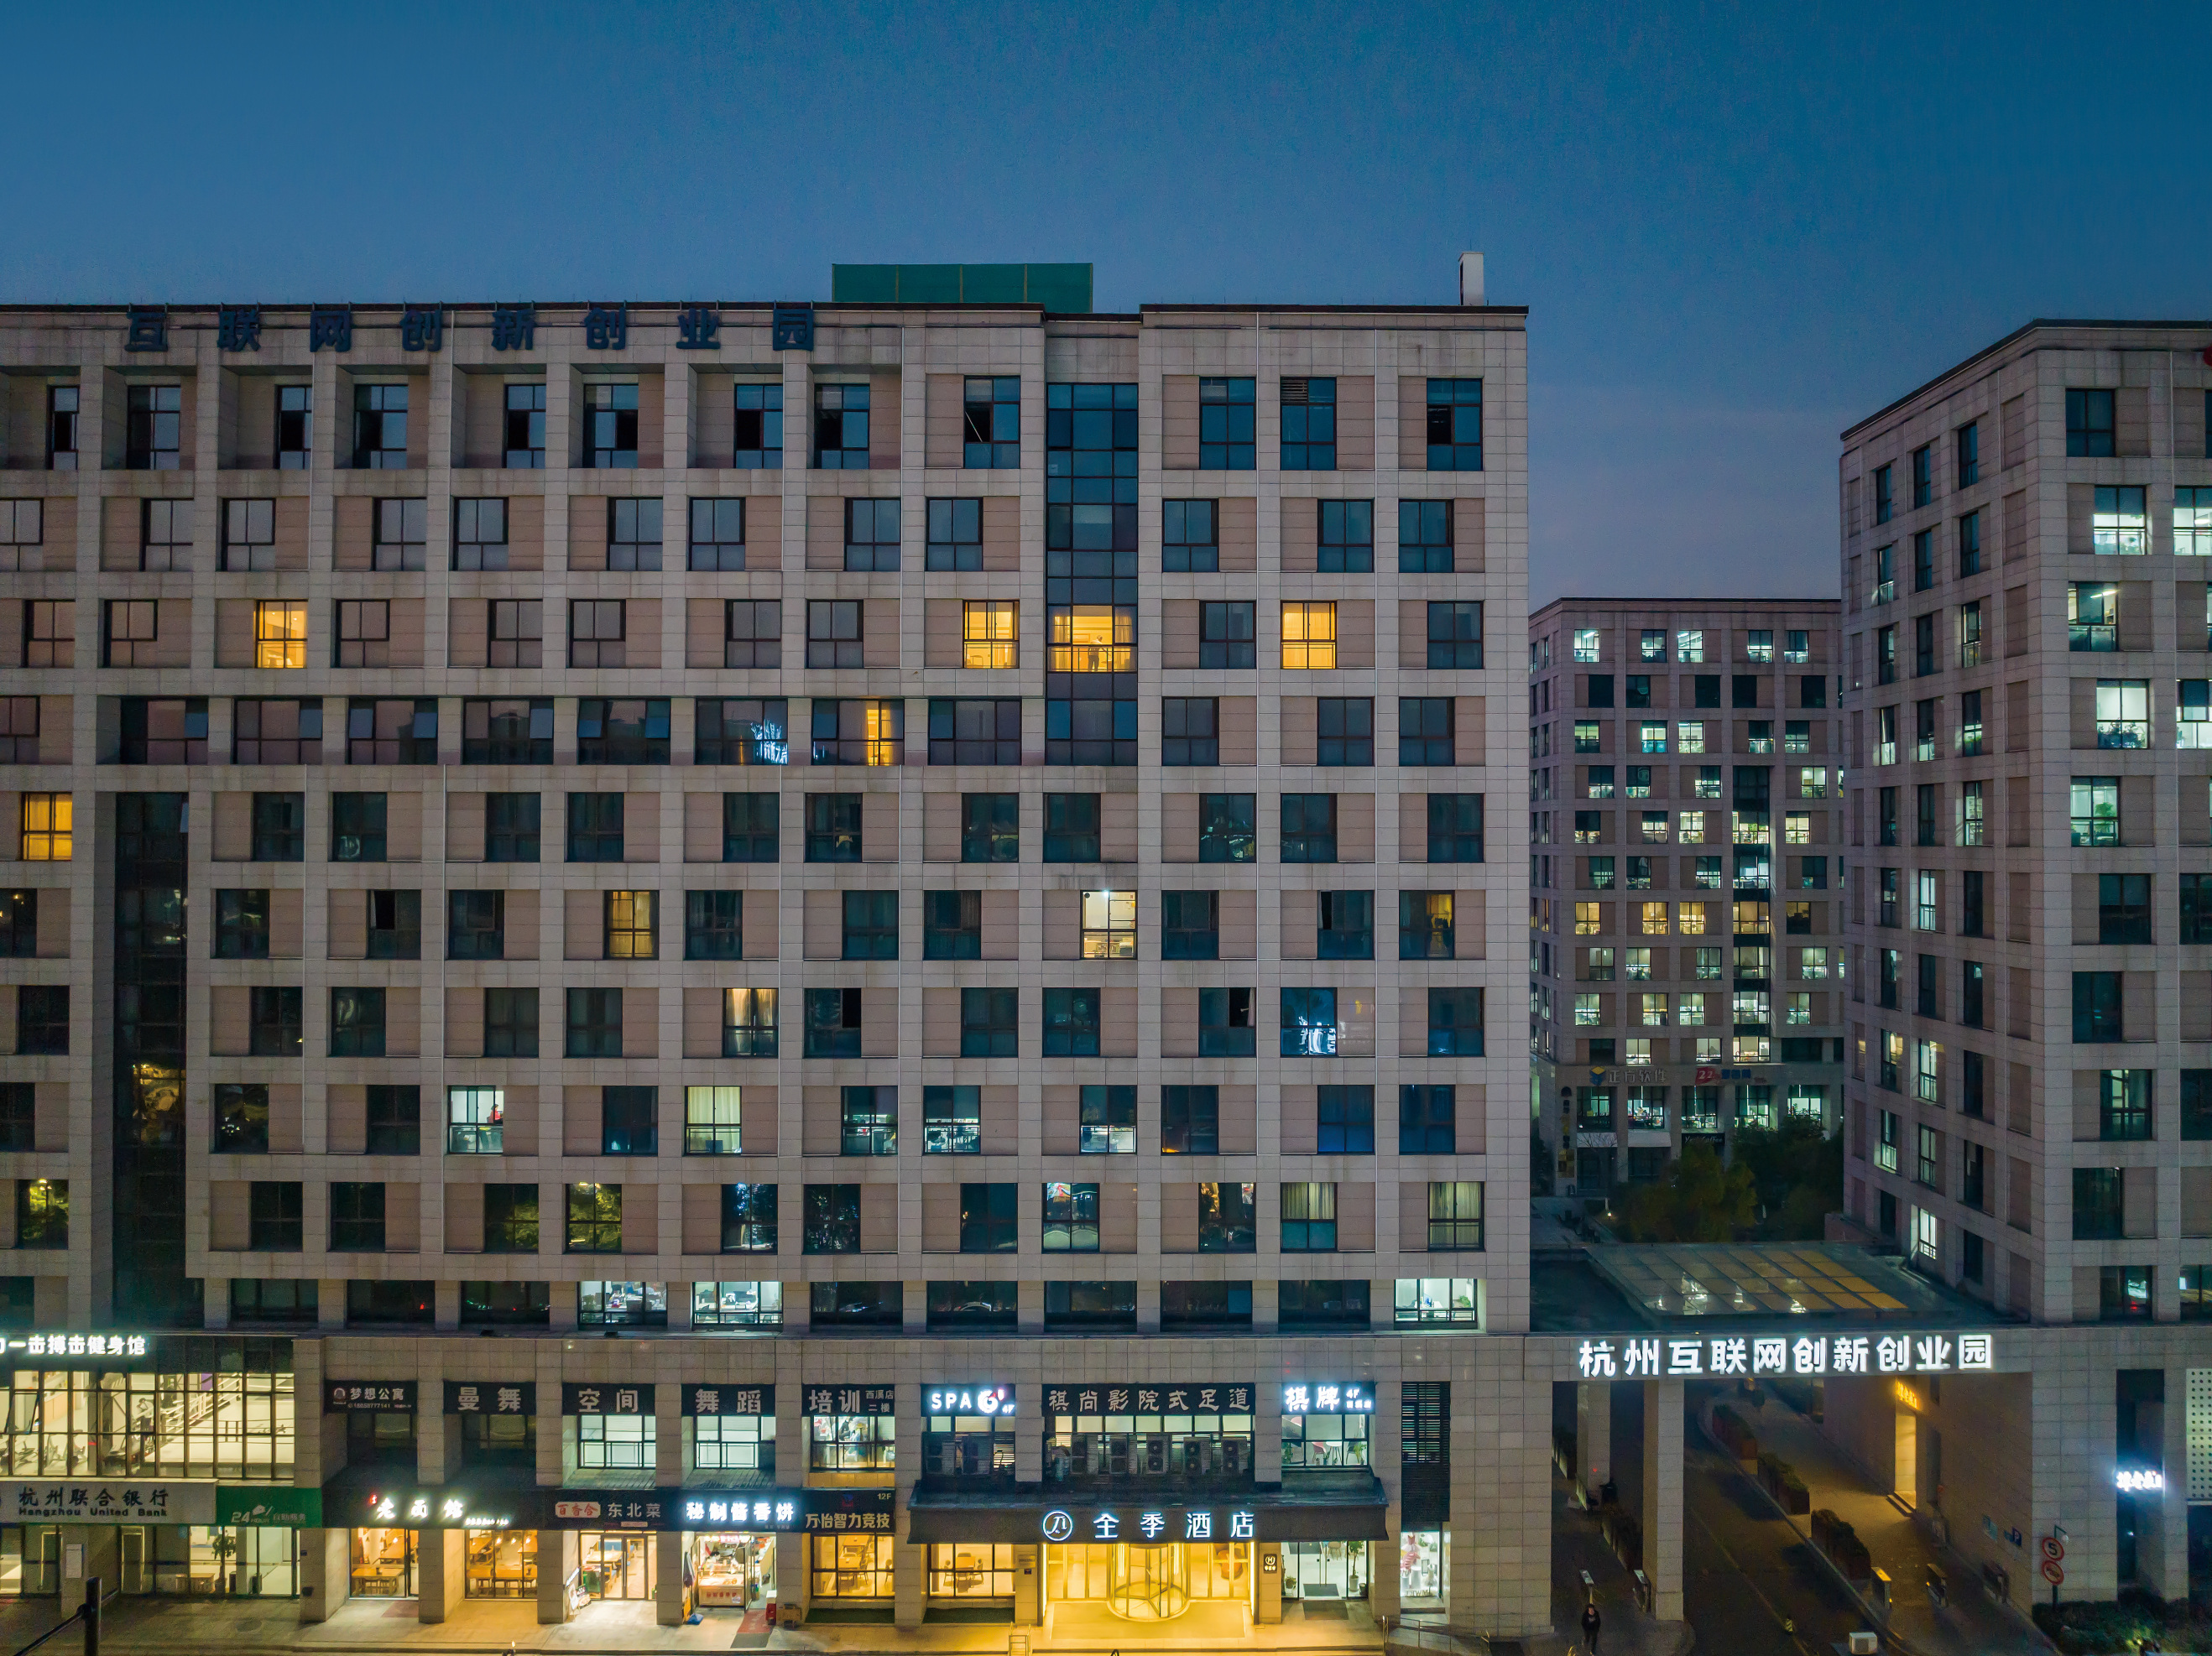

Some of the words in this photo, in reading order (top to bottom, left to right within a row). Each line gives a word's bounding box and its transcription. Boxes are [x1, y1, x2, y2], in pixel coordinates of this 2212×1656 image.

[124, 307, 815, 352] 互联网创新创业园
[1578, 1334, 1993, 1377] 杭州互联网创新创业园
[350, 1388, 404, 1400] 梦想公寓
[458, 1387, 522, 1412] 曼舞
[578, 1388, 639, 1413] 空间
[695, 1388, 761, 1414] 舞蹈
[809, 1389, 861, 1414] 培训
[866, 1390, 894, 1399] 西溪店
[931, 1393, 973, 1409] SPA
[1049, 1388, 1250, 1412] 祺尚影院式足道
[1286, 1386, 1340, 1412] 棋牌
[868, 1403, 890, 1413] 二楼
[18, 1487, 169, 1507] 杭州联合银行
[19, 1508, 81, 1517] Hangzhou
[90, 1508, 129, 1516] United
[138, 1508, 168, 1516] Bank
[231, 1511, 250, 1523] 24
[608, 1502, 661, 1518] 东北菜
[686, 1502, 794, 1521] 秘制酱香饼
[806, 1513, 890, 1528] 万怡智力竞技
[1093, 1511, 1255, 1539] 全季酒店
[2048, 1543, 2058, 1555] 5
